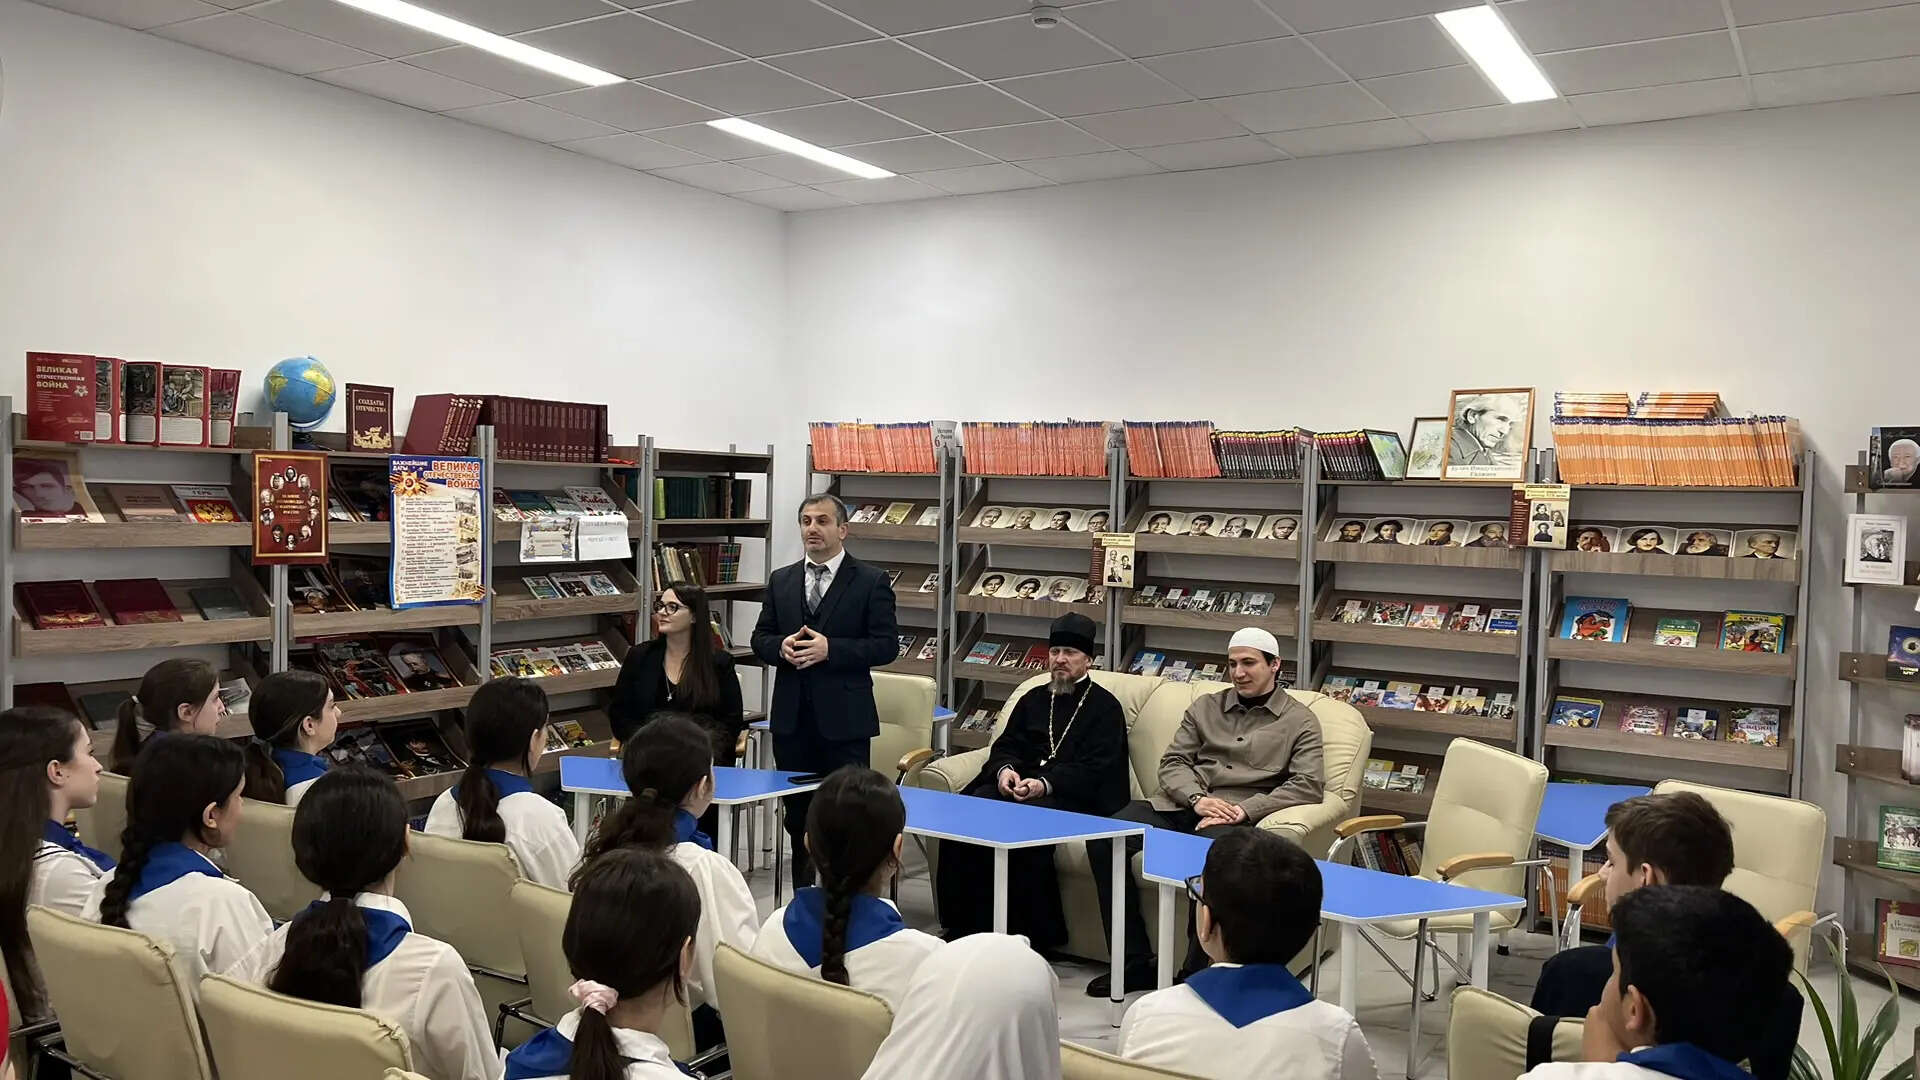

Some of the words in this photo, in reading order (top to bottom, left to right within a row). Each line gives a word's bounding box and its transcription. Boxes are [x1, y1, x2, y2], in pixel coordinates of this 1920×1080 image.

[36, 366, 78, 374] ВЕЛИКАЯ
[36, 381, 69, 389] ВОЙНА
[355, 405, 387, 413] ОТЕЧЕСТВА
[432, 461, 480, 471] ВЕЛИКАЯ
[423, 471, 480, 479] ОТЕЧЕСТВЕННАЯ
